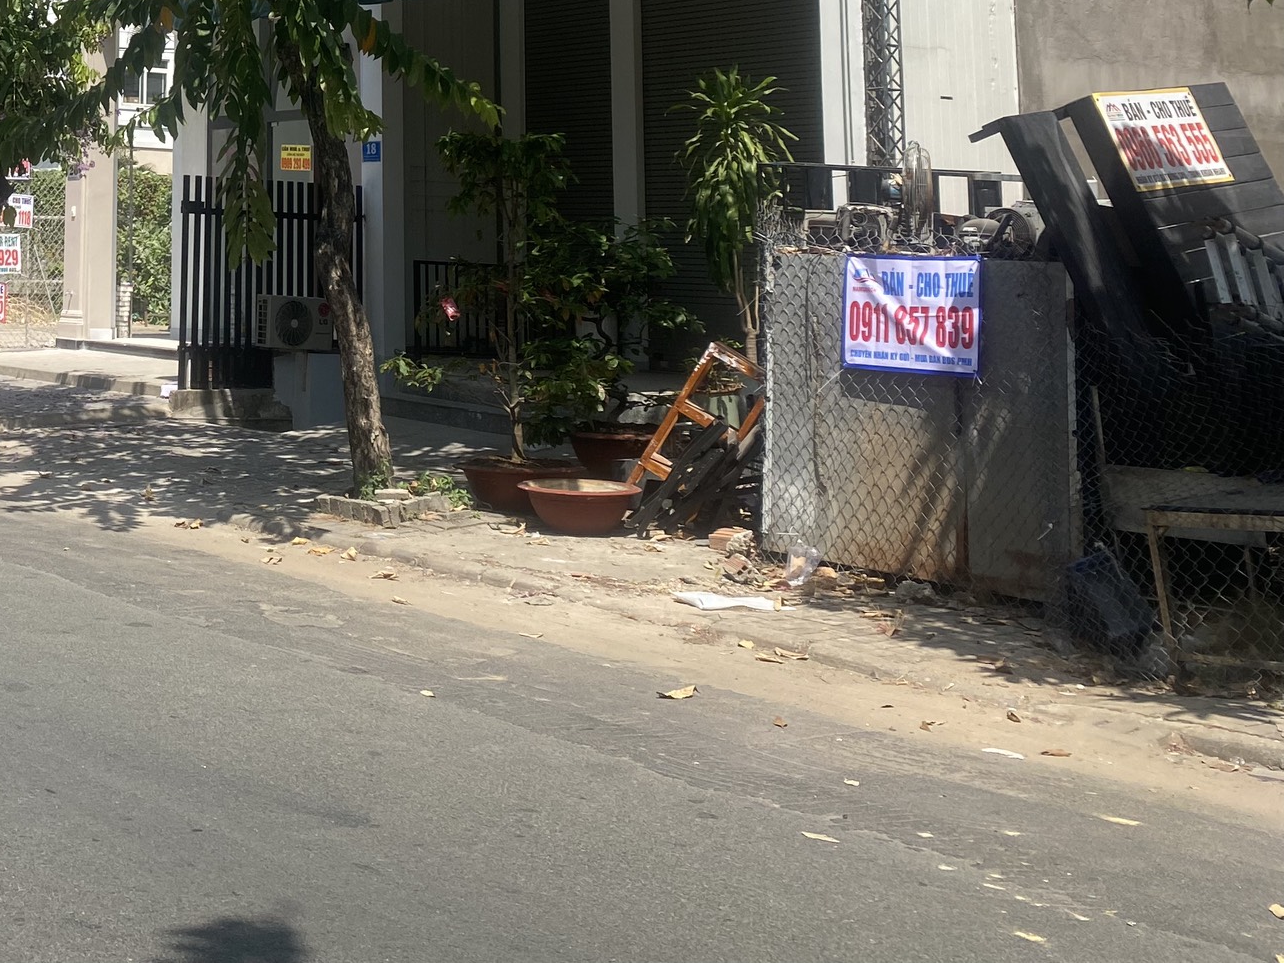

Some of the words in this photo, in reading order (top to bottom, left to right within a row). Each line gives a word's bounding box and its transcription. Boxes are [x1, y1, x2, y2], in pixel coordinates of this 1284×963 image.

[1121, 99, 1147, 121] BÁN
[1149, 101, 1173, 119] CHO
[1169, 95, 1197, 118] THUÊ
[366, 143, 377, 155] 18
[1151, 124, 1192, 168] 563
[1179, 122, 1219, 165] 555
[4, 236, 18, 247] RENT
[881, 267, 904, 297] BÁN
[916, 272, 941, 298] CHO
[945, 268, 975, 298] THUÊ
[849, 300, 890, 343] 0911
[935, 305, 974, 350] 839
